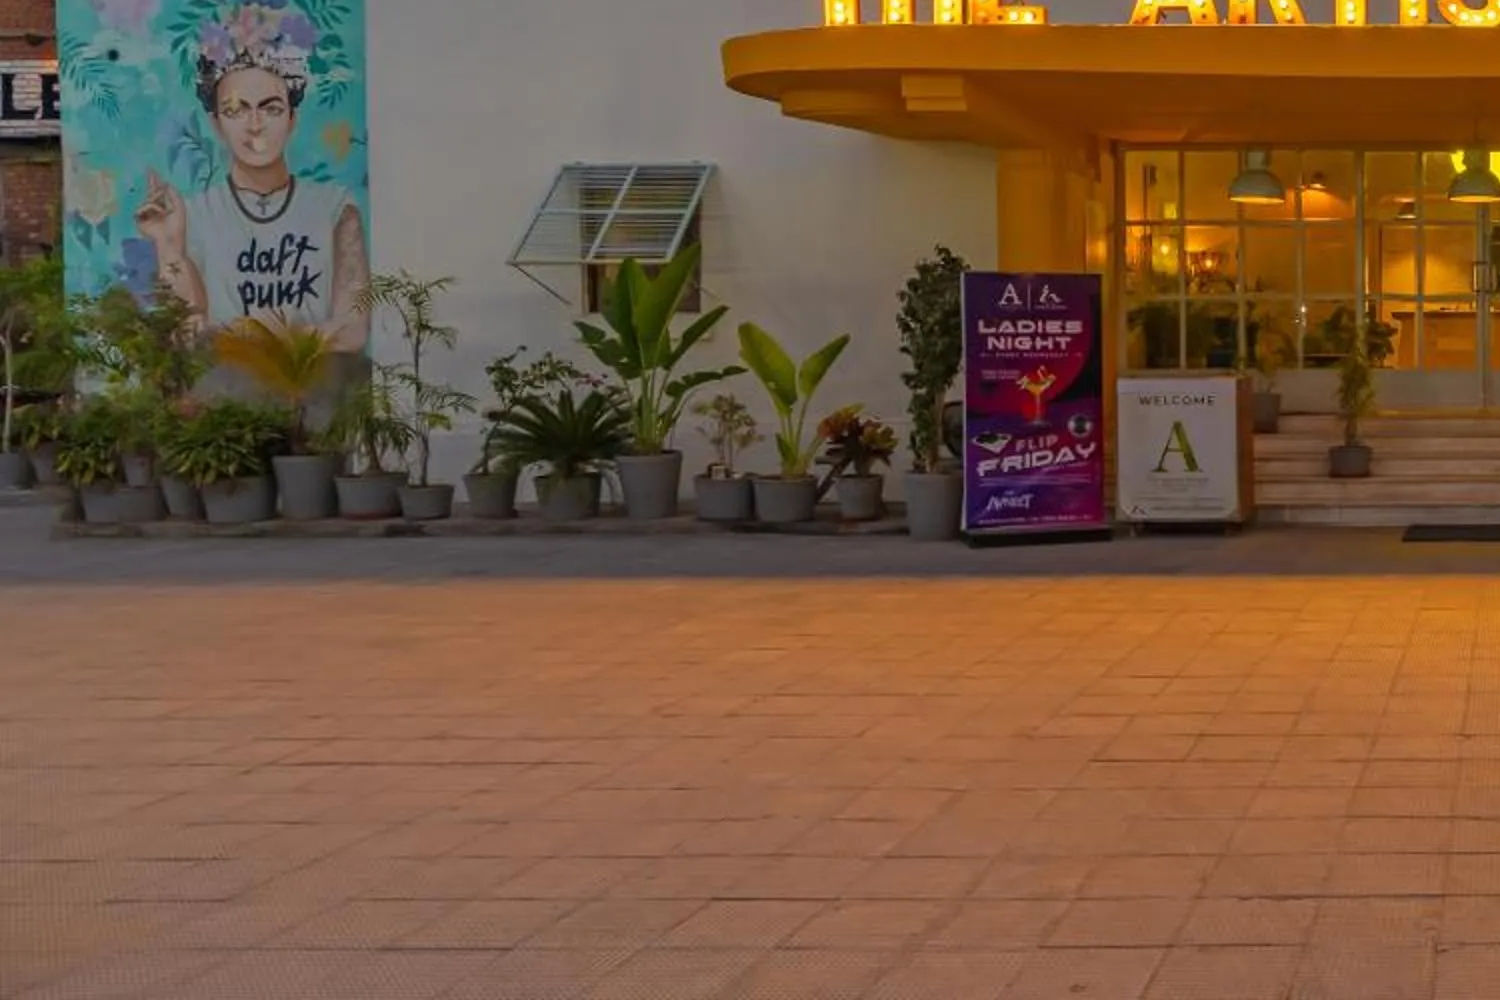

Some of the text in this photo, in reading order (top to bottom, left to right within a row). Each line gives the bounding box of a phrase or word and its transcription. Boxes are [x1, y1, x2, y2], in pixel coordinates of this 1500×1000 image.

[236, 233, 320, 276] daft
[236, 265, 323, 317] punk
[977, 319, 1083, 335] LADIES
[986, 335, 1073, 351] NIGHT
[1138, 395, 1217, 407] WELCOME
[1015, 434, 1059, 453] FLIP
[1150, 420, 1205, 474] A
[976, 440, 1097, 478] FRIDAY
